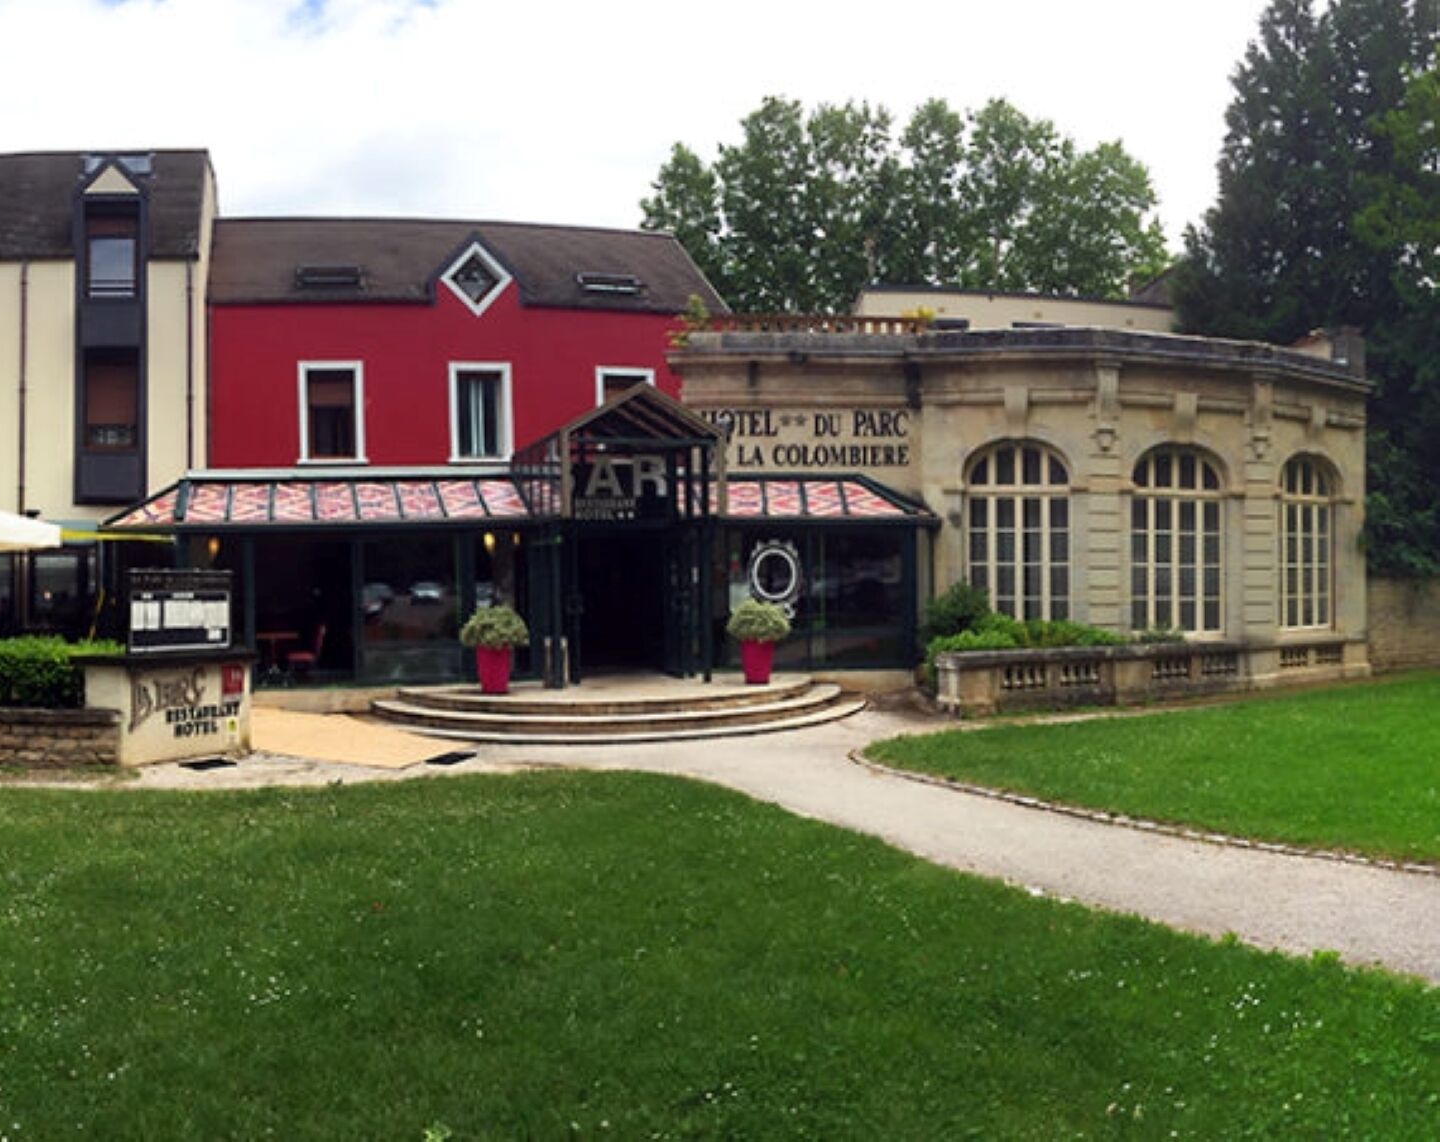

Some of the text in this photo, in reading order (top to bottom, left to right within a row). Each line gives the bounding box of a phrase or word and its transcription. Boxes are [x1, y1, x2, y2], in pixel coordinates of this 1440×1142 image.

[814, 413, 842, 437] DU
[853, 410, 909, 437] PARC
[737, 446, 763, 466] LA
[772, 446, 909, 467] COLOMBIERE
[563, 454, 668, 496] AR
[174, 720, 217, 737] HOTEL
